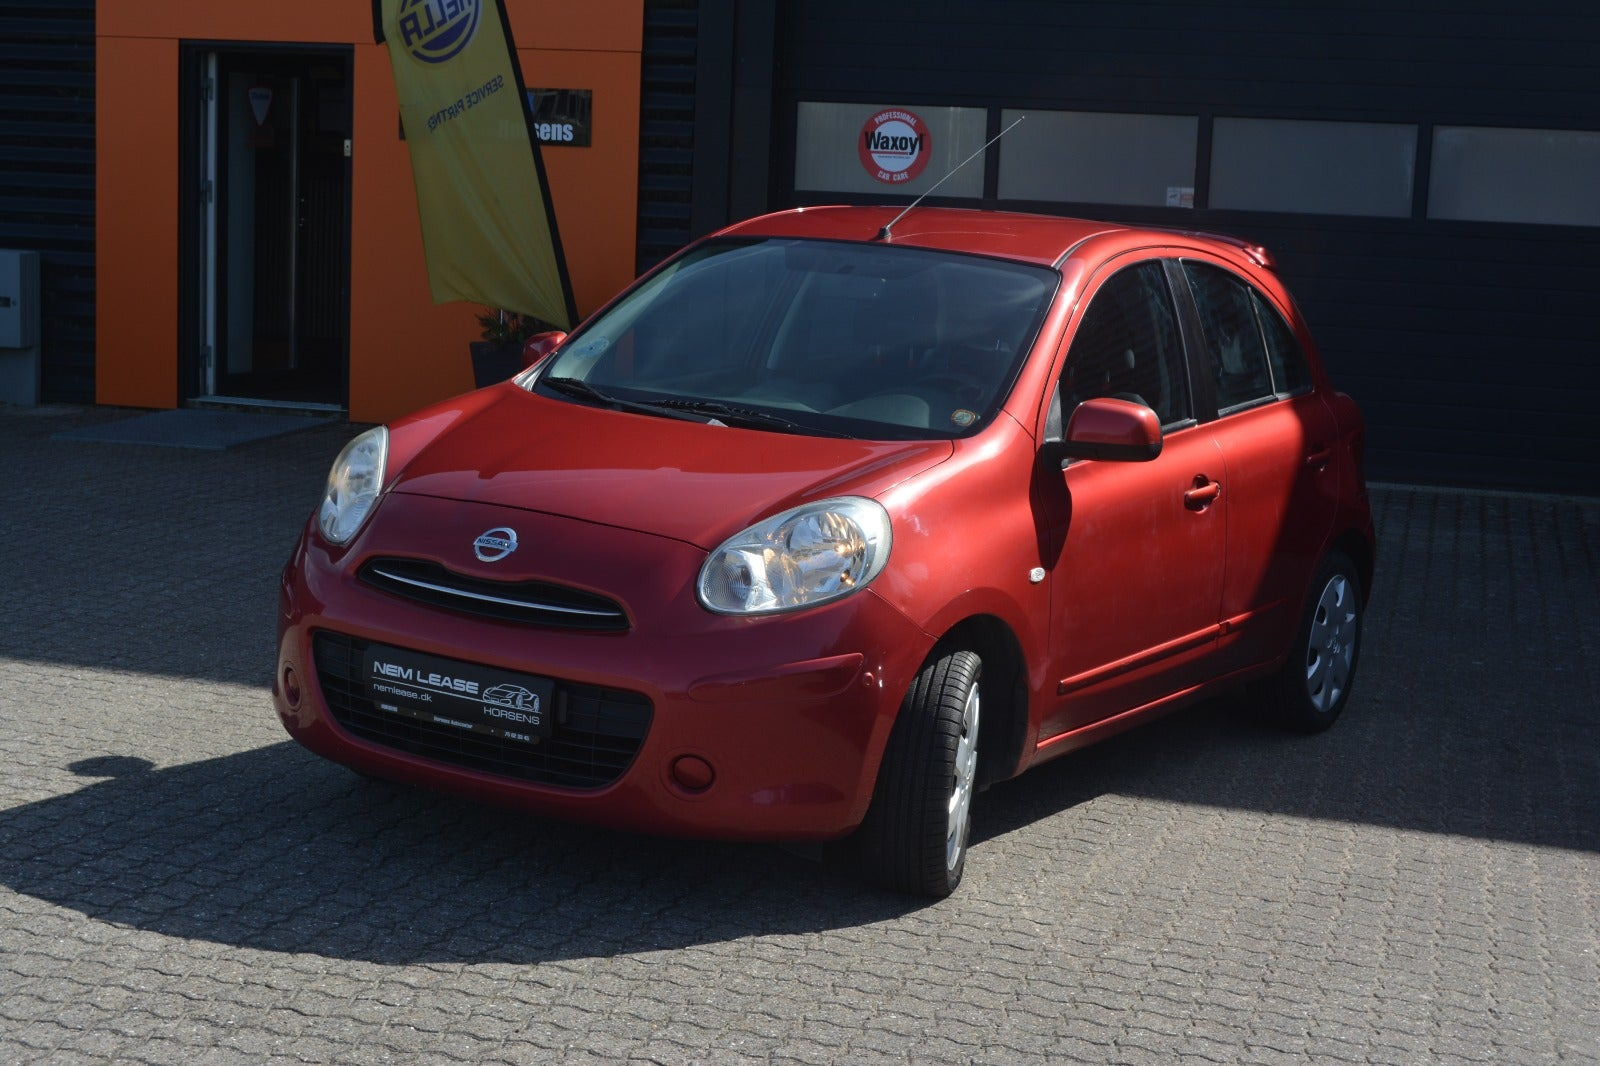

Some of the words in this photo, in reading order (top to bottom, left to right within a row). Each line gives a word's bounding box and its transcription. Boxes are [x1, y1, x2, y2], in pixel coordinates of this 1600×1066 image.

[874, 111, 917, 126] PROFESSIONAL
[865, 131, 924, 156] Waxoyl
[877, 171, 890, 181] CAR
[893, 171, 909, 182] CARE
[373, 660, 413, 681] NEM
[416, 670, 479, 694] LEASE
[373, 683, 433, 702] nemlease.dk
[483, 706, 540, 725] HORSENS
